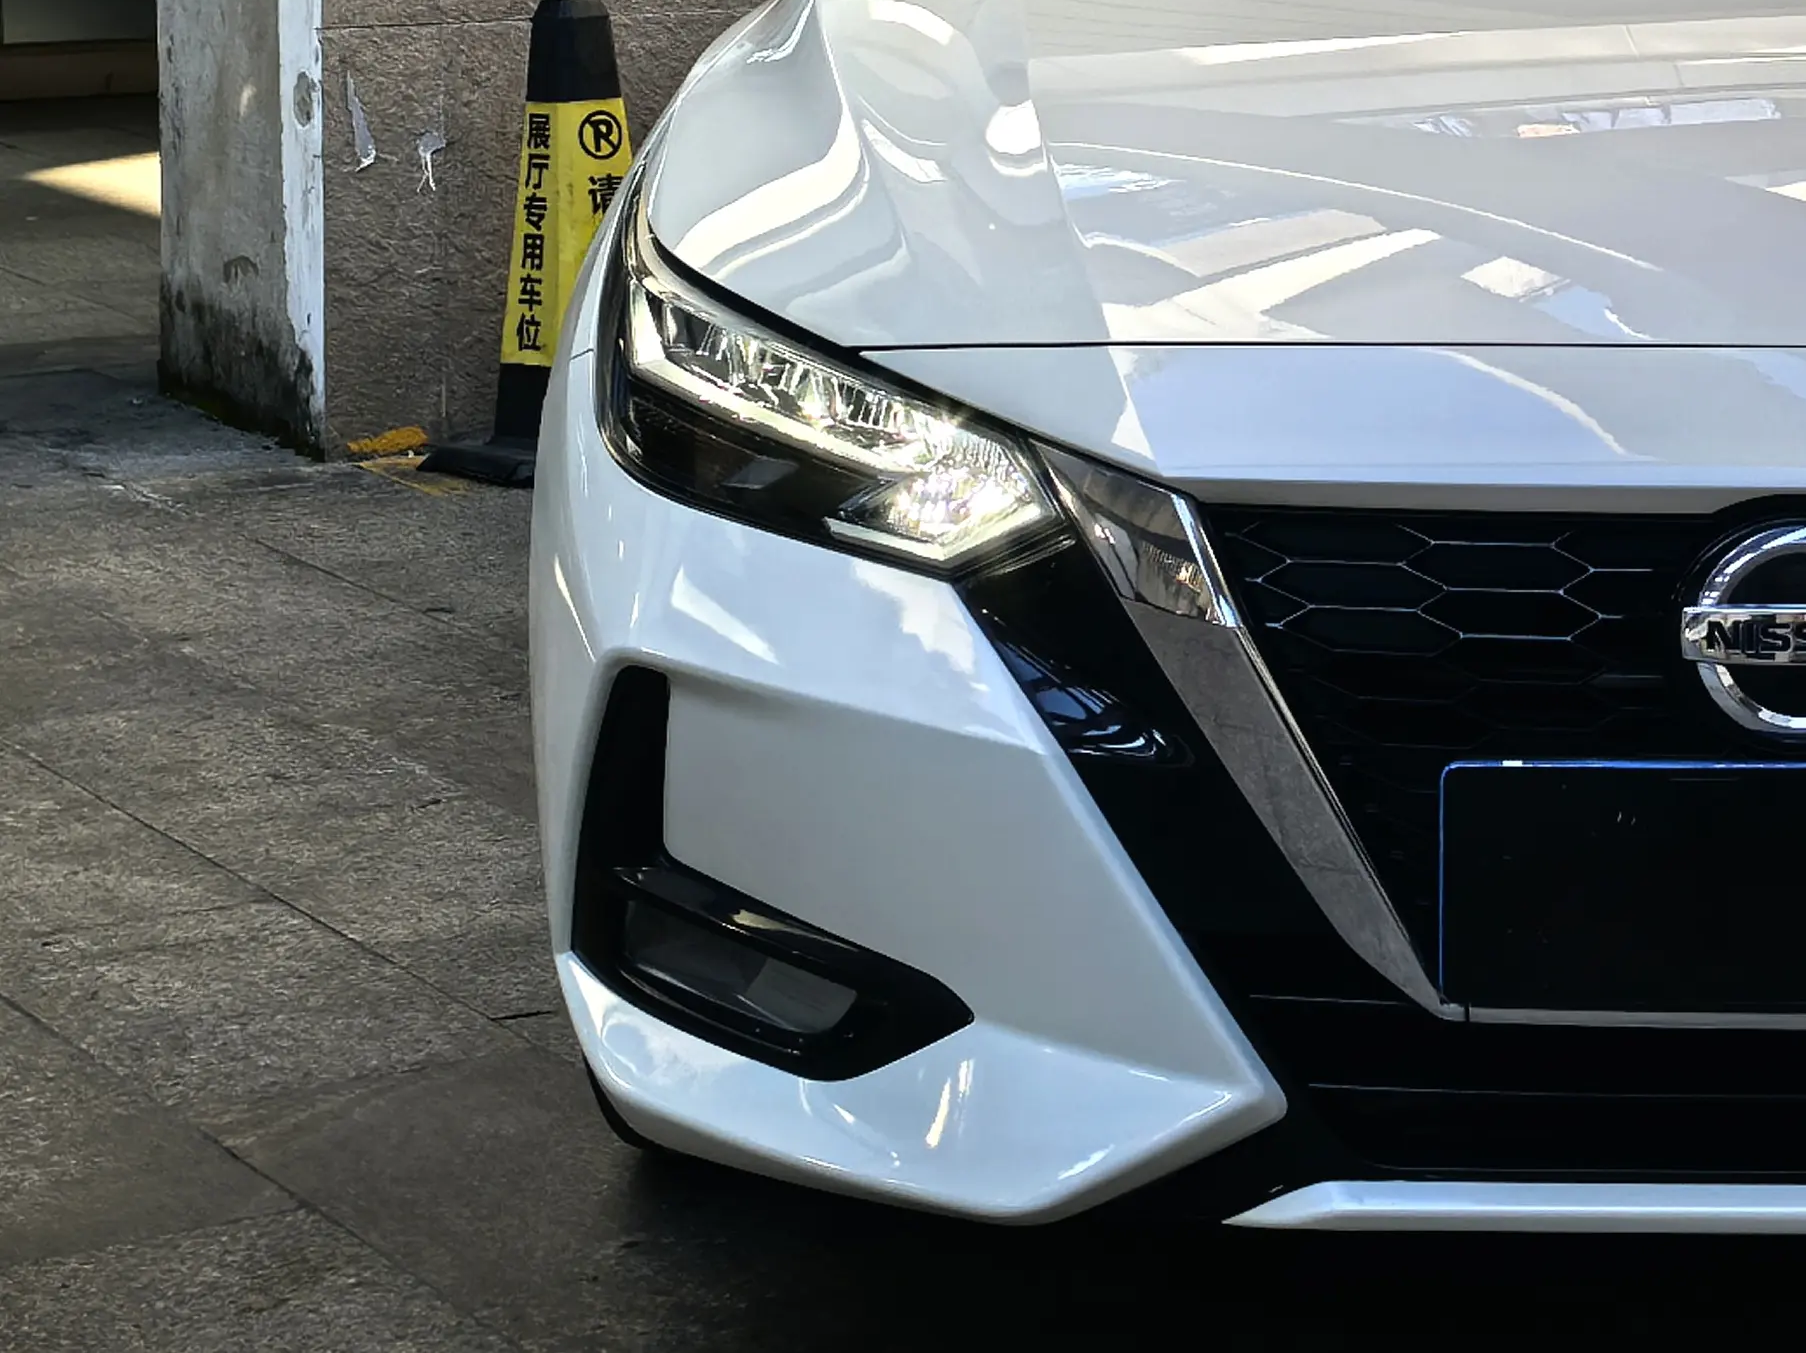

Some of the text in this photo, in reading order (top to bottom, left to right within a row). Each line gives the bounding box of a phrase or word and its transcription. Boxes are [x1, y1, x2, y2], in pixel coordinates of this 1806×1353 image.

[515, 112, 551, 352] 展厅专用车位
